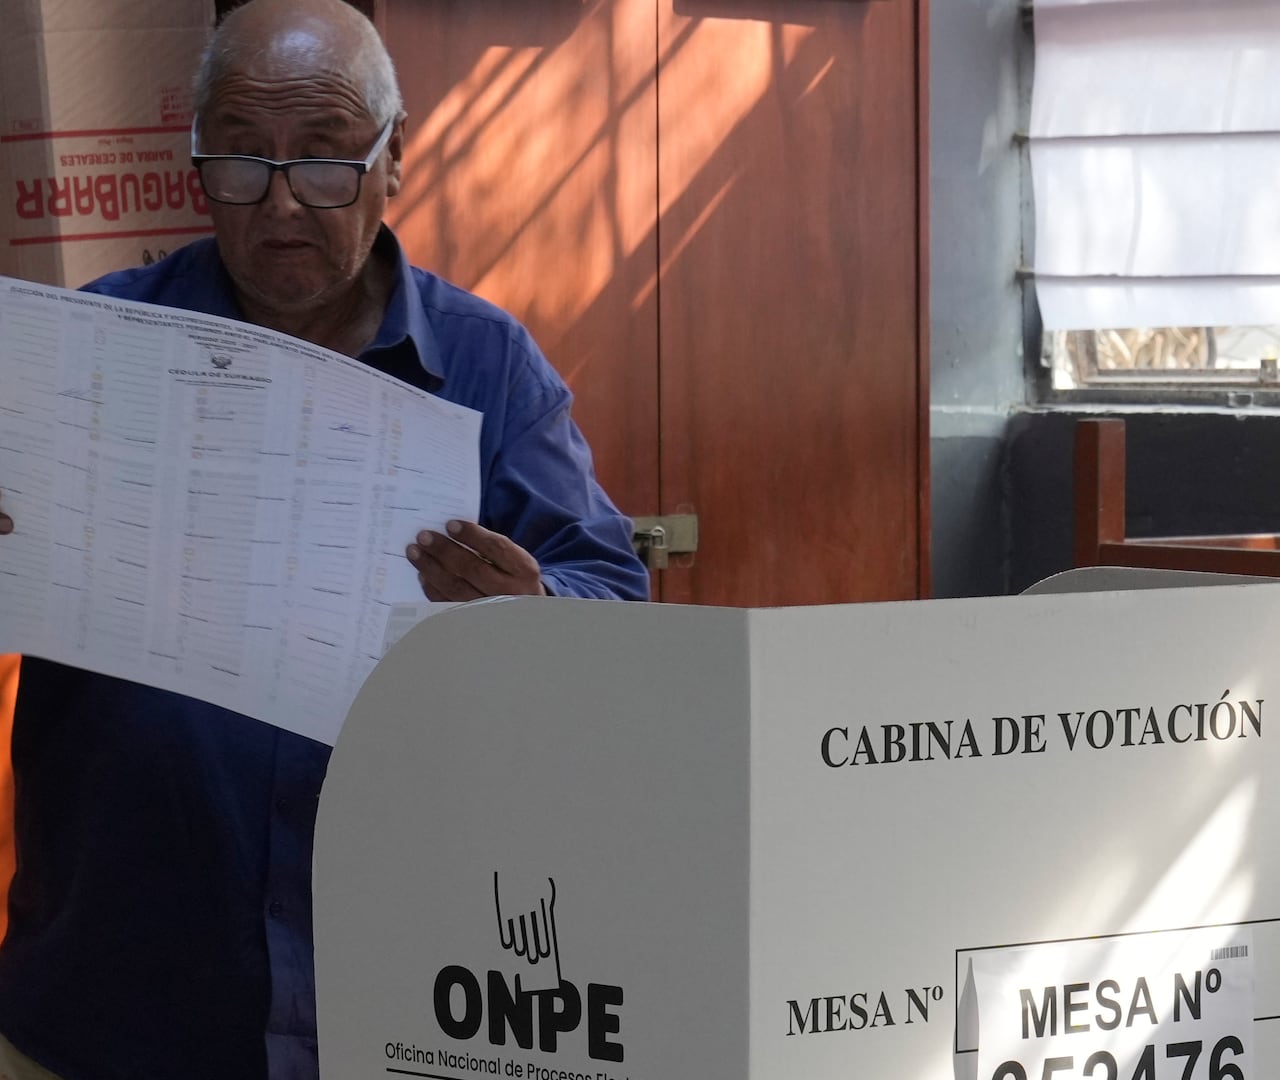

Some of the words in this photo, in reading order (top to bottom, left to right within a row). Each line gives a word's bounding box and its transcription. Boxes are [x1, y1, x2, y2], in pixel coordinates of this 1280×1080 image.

[59, 153, 117, 167] CEREALES
[119, 152, 133, 164] DE
[821, 718, 982, 768] CABINA
[992, 714, 1047, 756] DE
[1058, 689, 1264, 751] VOTACIÓN
[433, 964, 624, 1063] ONPE
[786, 991, 894, 1036] MESA
[1020, 976, 1158, 1039] MESA
[385, 1042, 434, 1065] Oficina
[438, 1049, 501, 1075] Nacional
[504, 1059, 523, 1078] de
